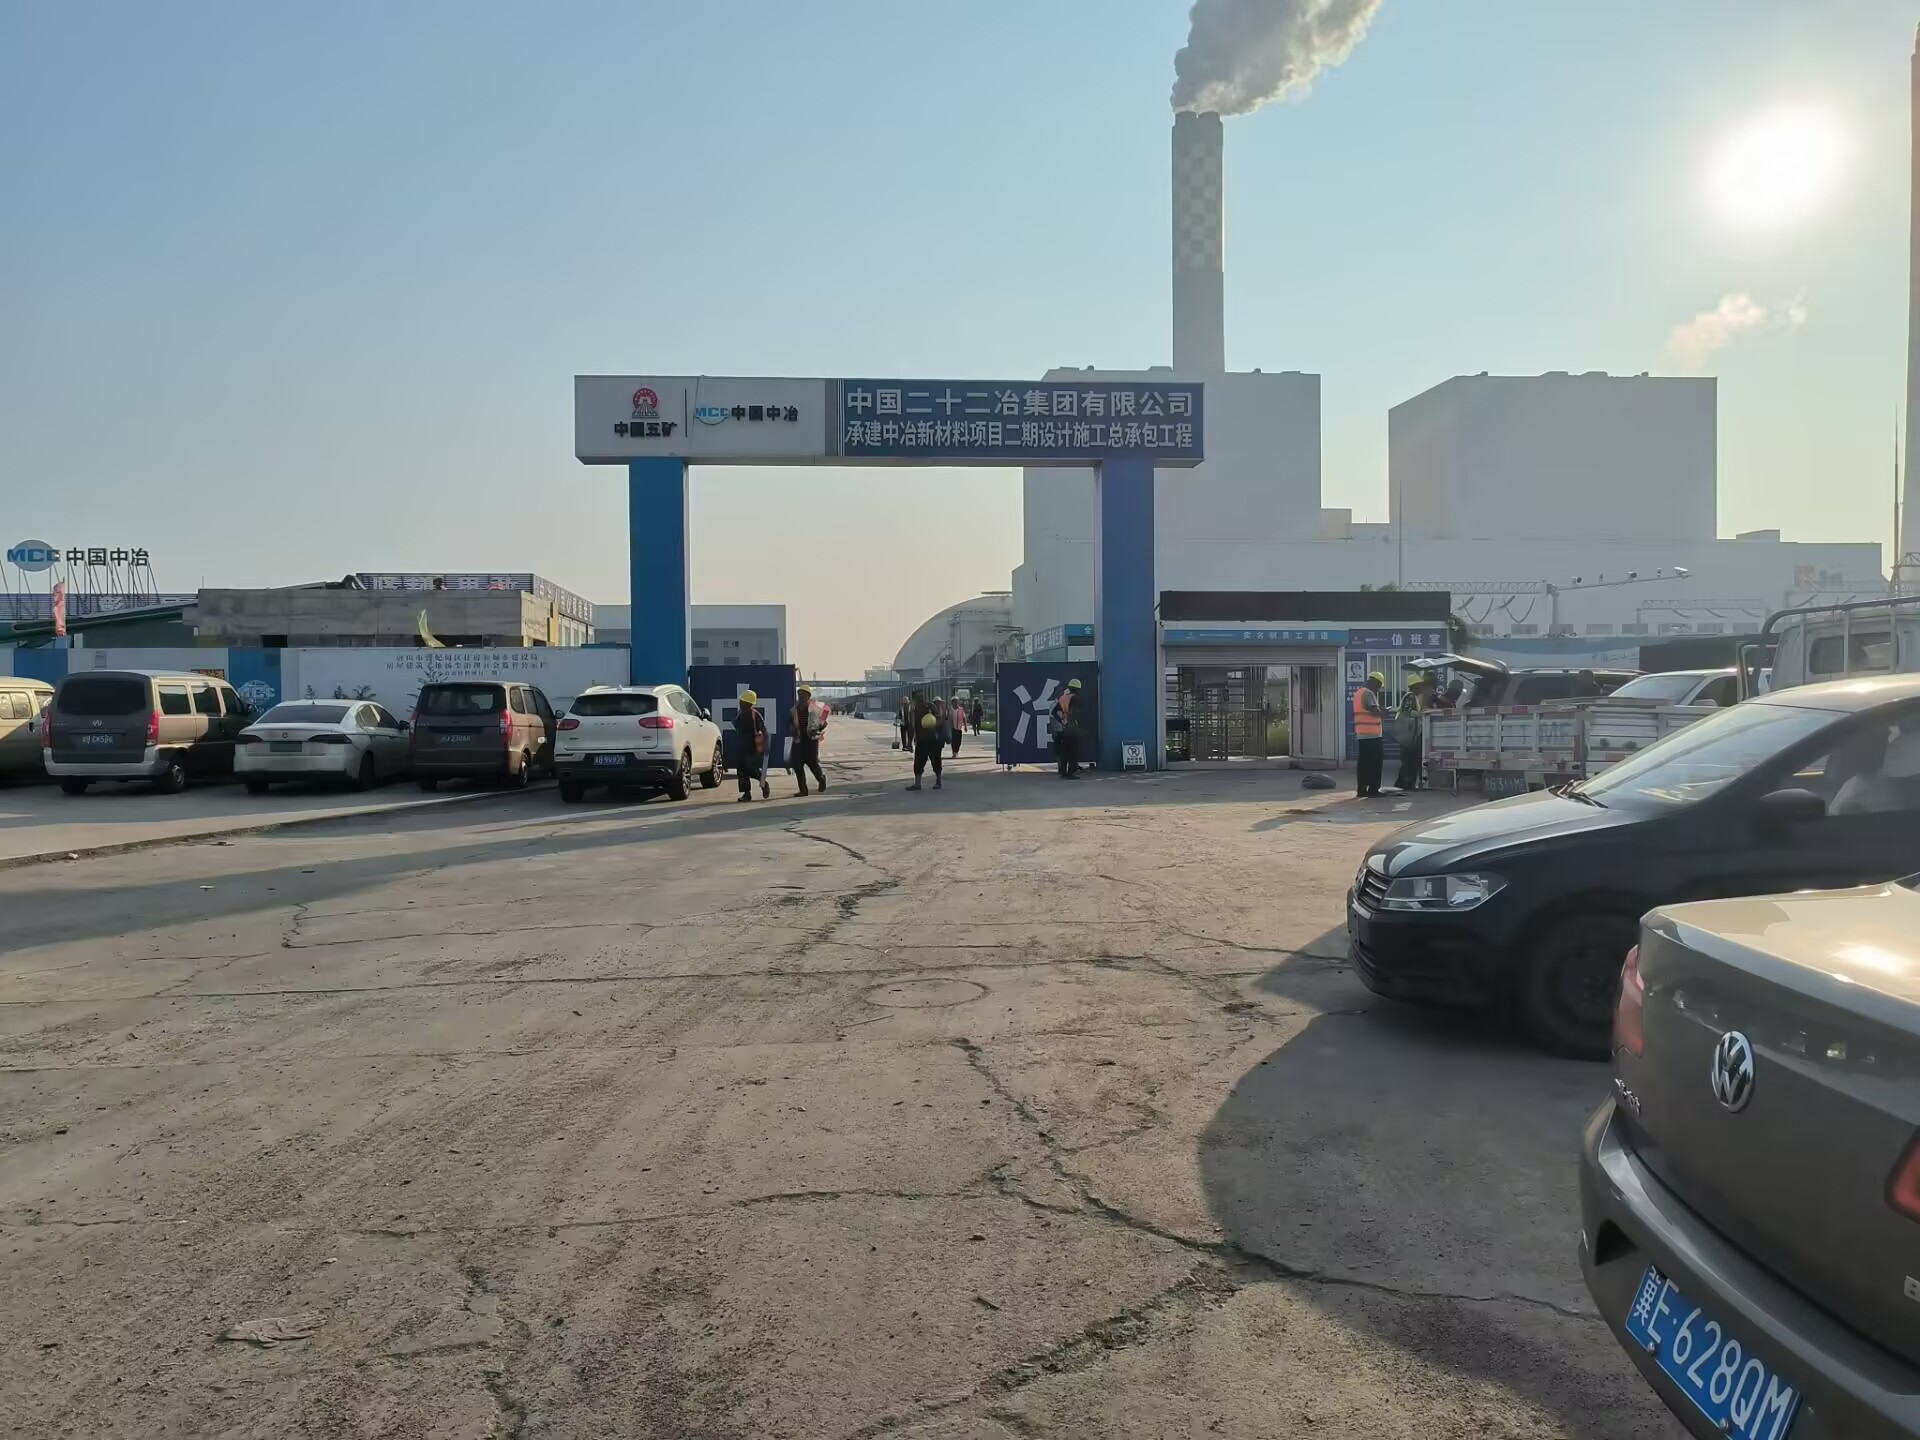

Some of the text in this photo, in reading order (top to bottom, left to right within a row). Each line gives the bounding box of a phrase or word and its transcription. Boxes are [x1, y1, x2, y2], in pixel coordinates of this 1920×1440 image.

[846, 388, 1193, 417] 中国二十二冶集团有限公司
[695, 407, 730, 418] MCC
[731, 404, 799, 422] 中国中冶
[614, 421, 678, 438] 中国五矿
[845, 420, 1193, 449] 承建中冶新材料项目二期设计施工总承包工程
[7, 548, 61, 562] MCC
[66, 546, 150, 567] 中国中冶
[1392, 632, 1441, 646] 值班室
